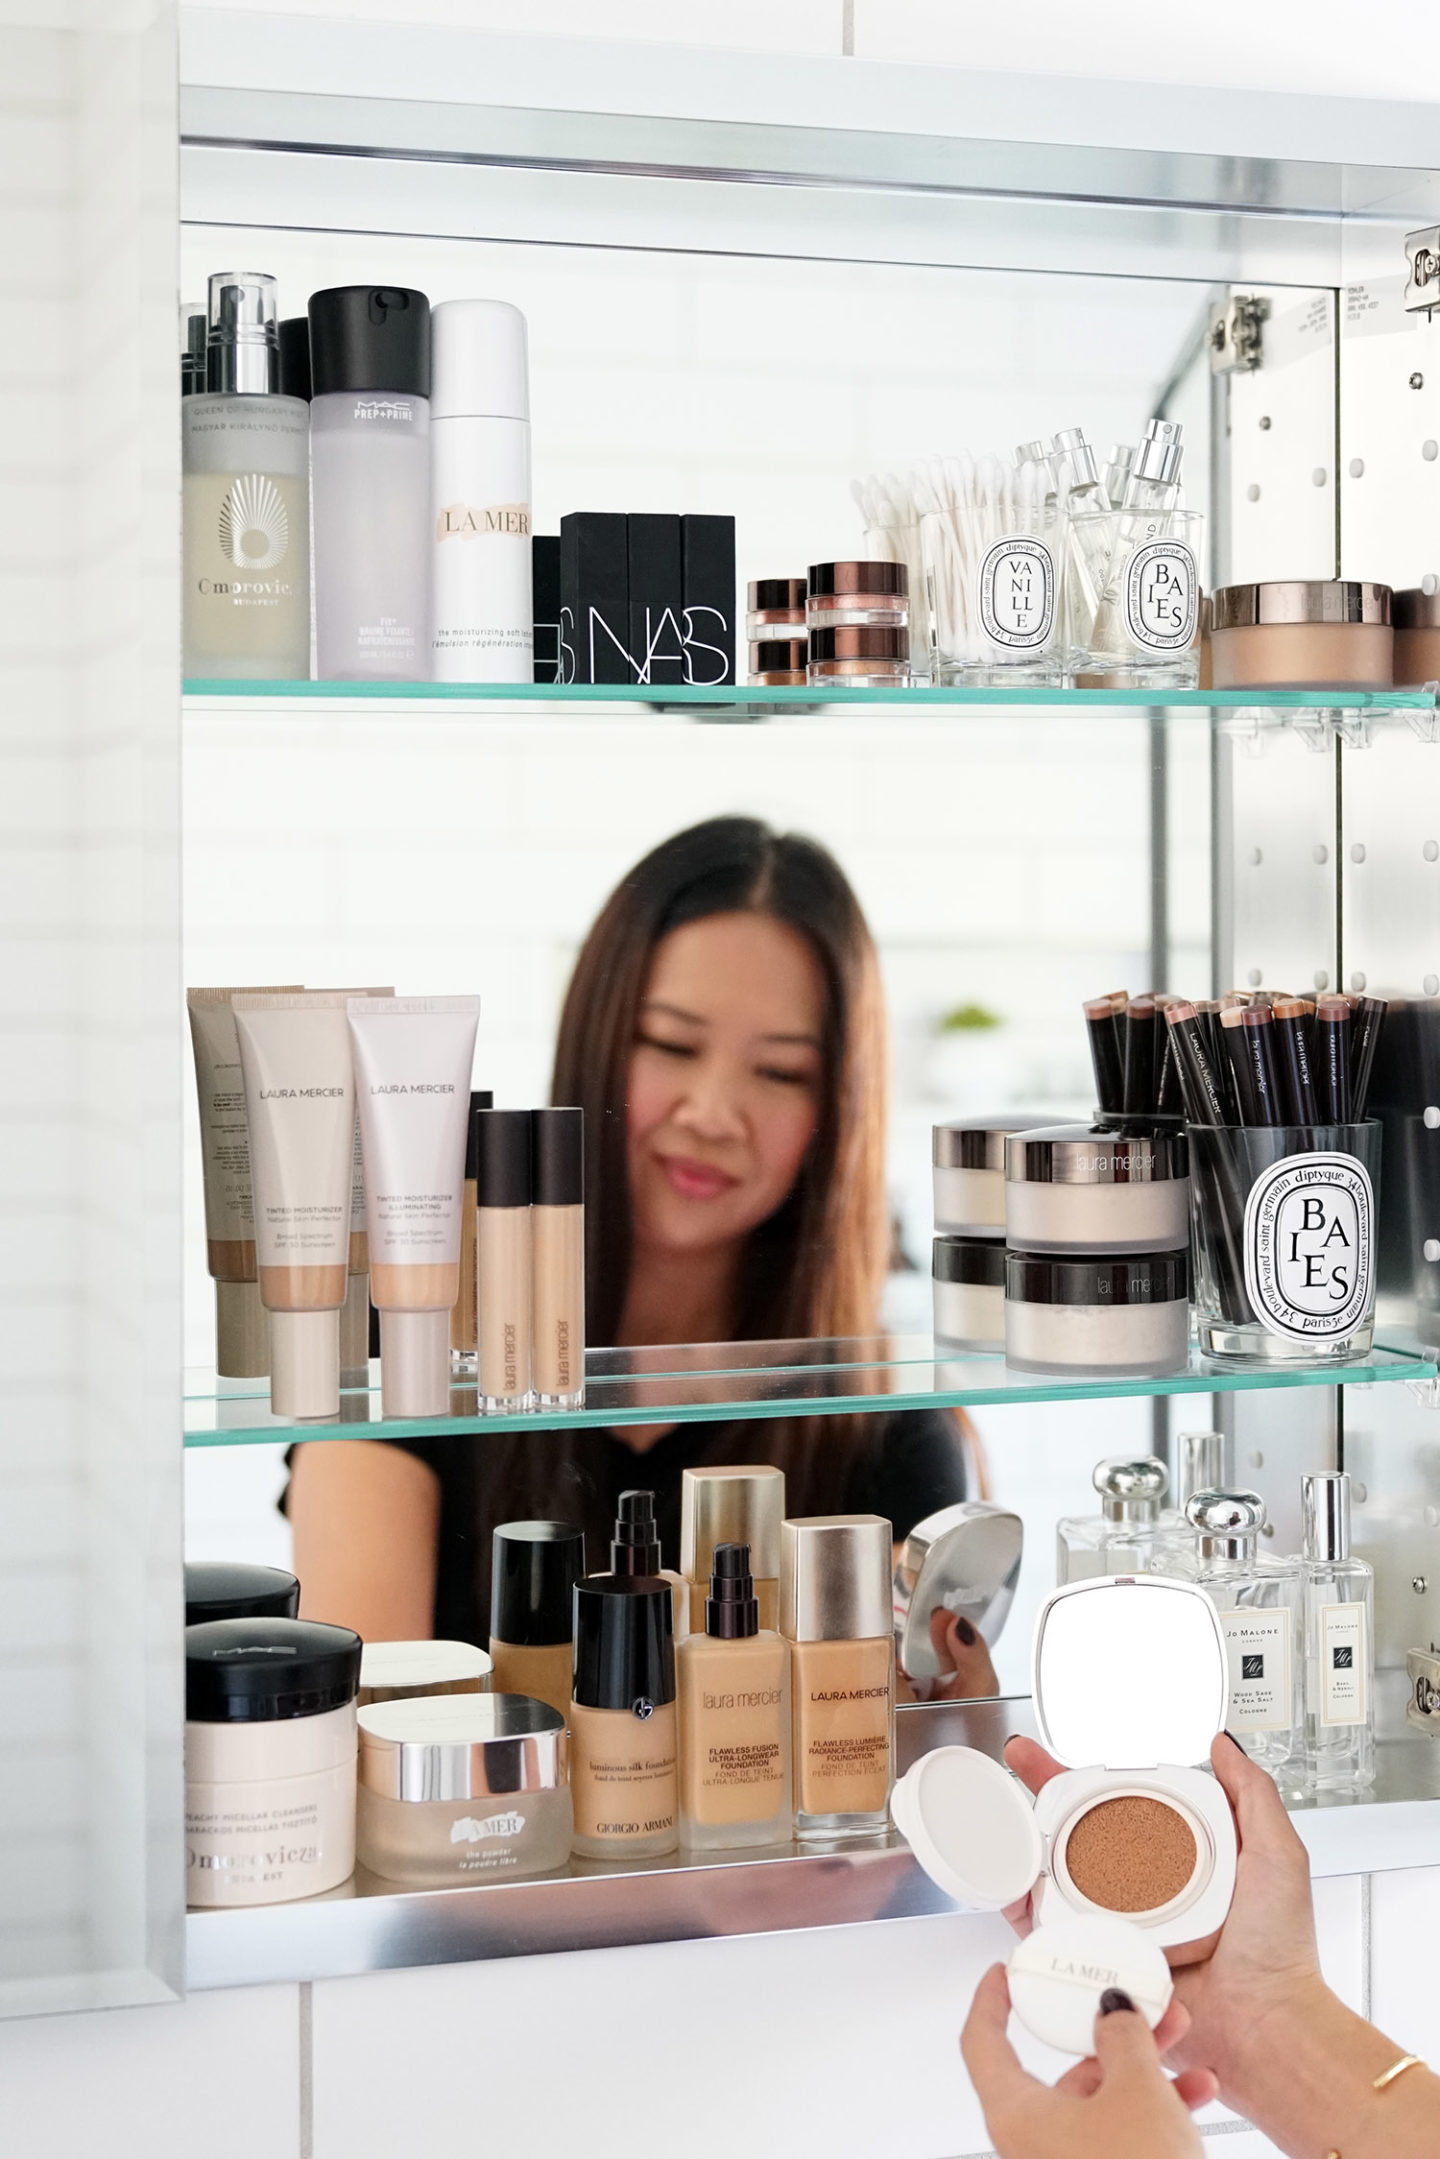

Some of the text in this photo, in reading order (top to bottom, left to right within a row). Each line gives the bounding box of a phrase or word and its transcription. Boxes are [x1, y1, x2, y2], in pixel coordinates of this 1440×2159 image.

[357, 400, 411, 411] MAC
[354, 409, 413, 421] PREP+PRIME
[446, 511, 528, 535] LA MER
[1189, 1032, 1222, 1114] LAURA MERCIER
[259, 1087, 345, 1100] LAURA MERCIER
[370, 1083, 455, 1096] LAURA MERCIER
[1076, 1152, 1157, 1171] laura mercier
[1294, 1170, 1345, 1185] diptyque
[1263, 1177, 1292, 1223] germain
[1258, 1224, 1271, 1254] saint
[1358, 1244, 1368, 1273] saint
[1258, 1255, 1283, 1316] boulevard
[1347, 1274, 1367, 1319] germain
[1280, 1307, 1299, 1324] 34
[501, 1322, 517, 1391] laura mercier
[554, 1319, 570, 1387] laura mercier
[703, 1686, 783, 1710] laura mercier
[810, 1686, 890, 1702] LAURA MERCIER
[709, 1743, 779, 1756] FLAWLESS FUSION
[808, 1742, 890, 1755] RADIANCE-PERFECTING
[813, 1738, 854, 1748] FLAWLESS
[708, 1750, 780, 1763] ULTRA-LONGWEAR
[826, 1752, 875, 1762] FOUNDATION
[589, 1760, 627, 1773] luminous
[628, 1761, 643, 1772] silk
[720, 1759, 770, 1770] FOUNDATION
[715, 1766, 774, 1779] FOND DE TEINT
[596, 1822, 640, 1834] GIORGIO
[1050, 1956, 1119, 1986] LA MER
